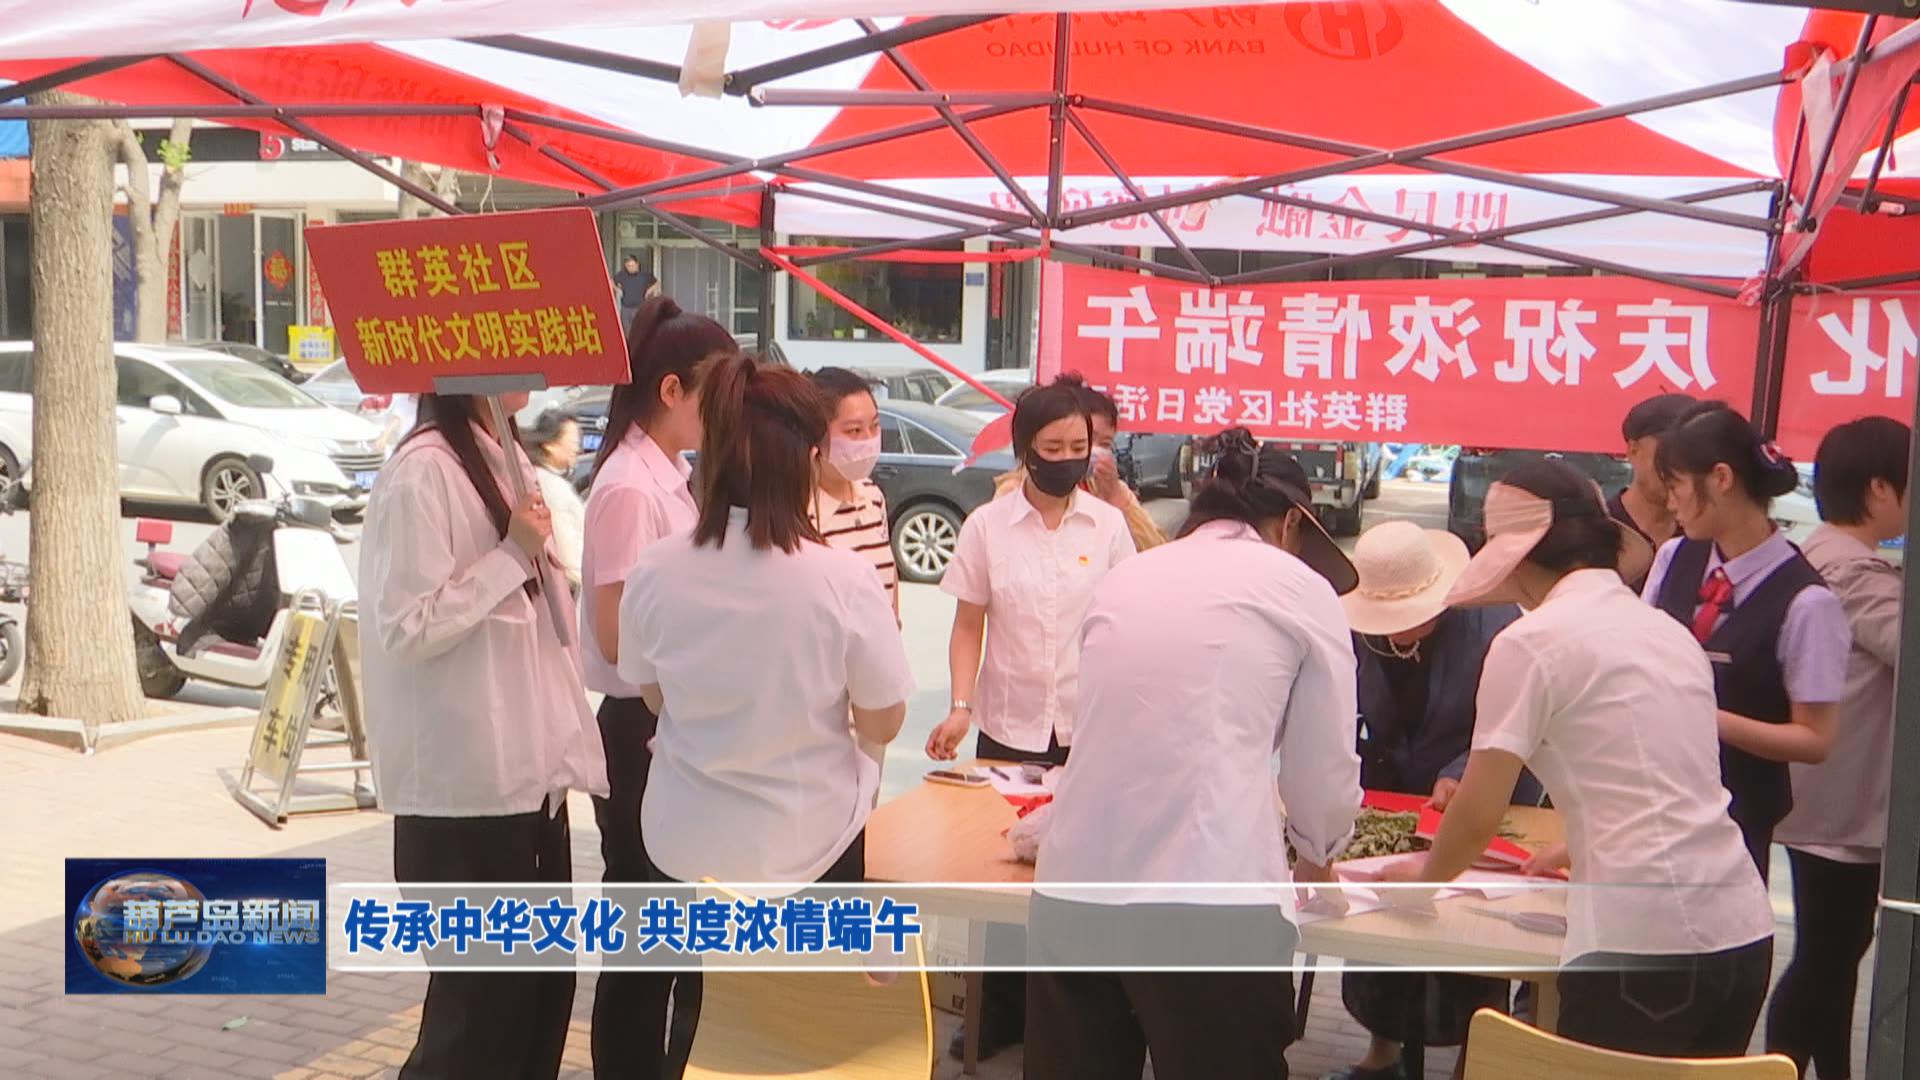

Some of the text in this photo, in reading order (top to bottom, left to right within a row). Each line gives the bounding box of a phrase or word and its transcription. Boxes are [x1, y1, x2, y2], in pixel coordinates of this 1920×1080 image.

[377, 243, 540, 299] 群英社区
[354, 304, 605, 368] 新时代文明实践站
